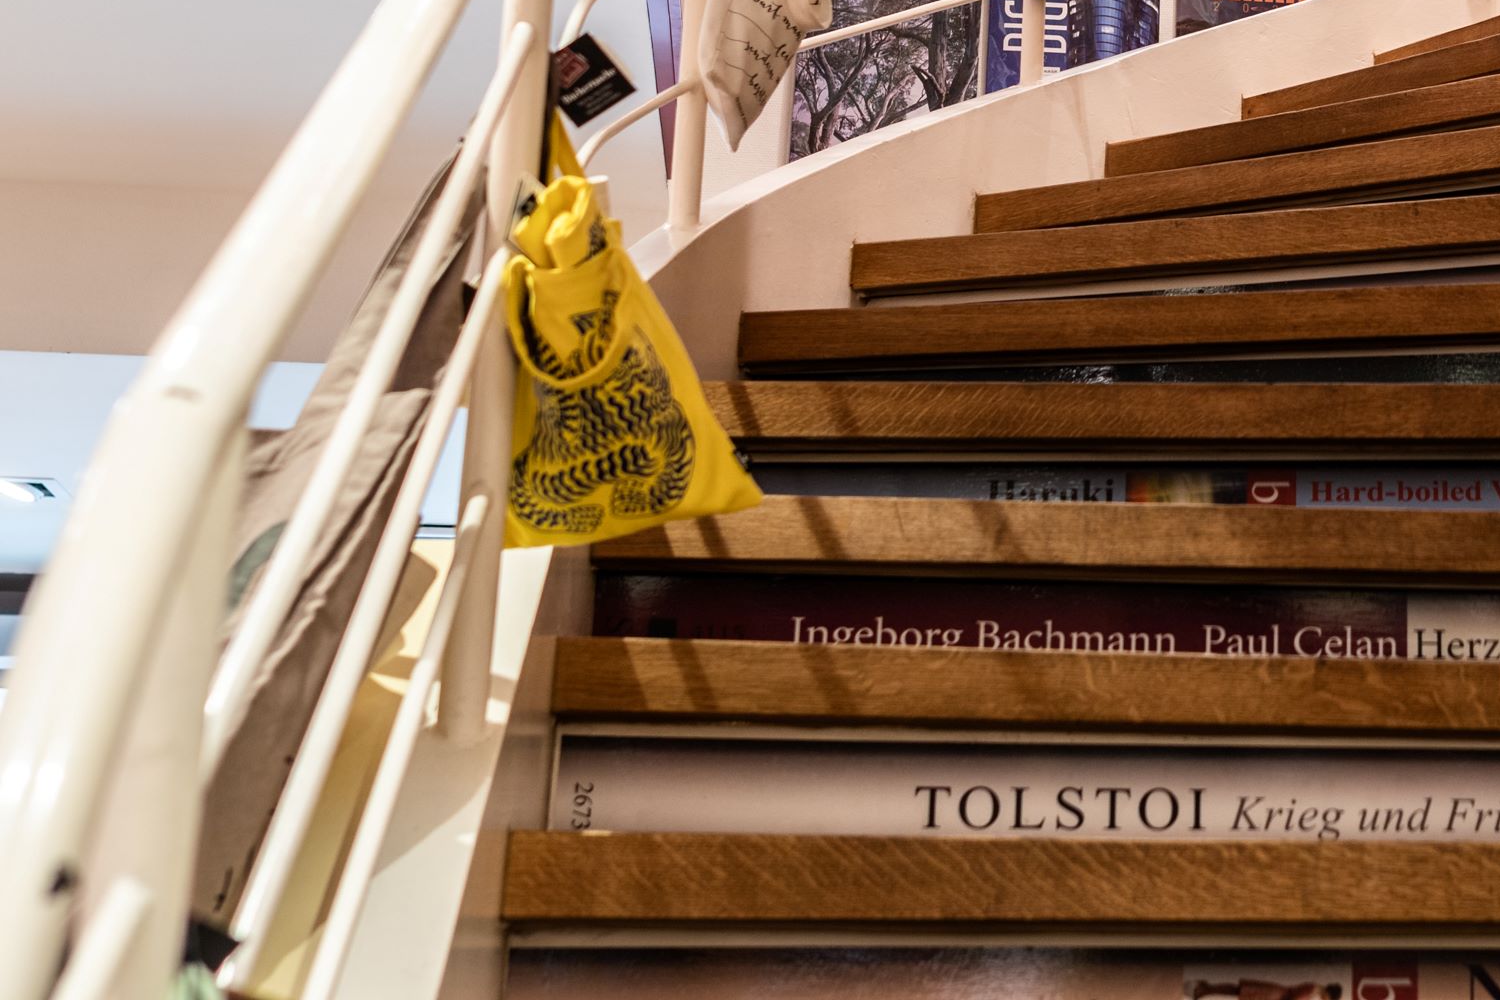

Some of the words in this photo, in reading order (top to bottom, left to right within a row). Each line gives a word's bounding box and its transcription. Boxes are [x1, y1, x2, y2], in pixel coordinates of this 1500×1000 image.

[989, 478, 1115, 503] Haruki
[1311, 480, 1482, 503] Hard-boiled
[791, 616, 964, 647] Ingeborg
[976, 619, 1177, 654] Bachmann
[1203, 623, 1280, 657] Paul
[1293, 624, 1398, 659] Celan
[914, 784, 1207, 832] TOLSTOI
[1229, 795, 1343, 841] Krieg
[1358, 796, 1433, 835] und
